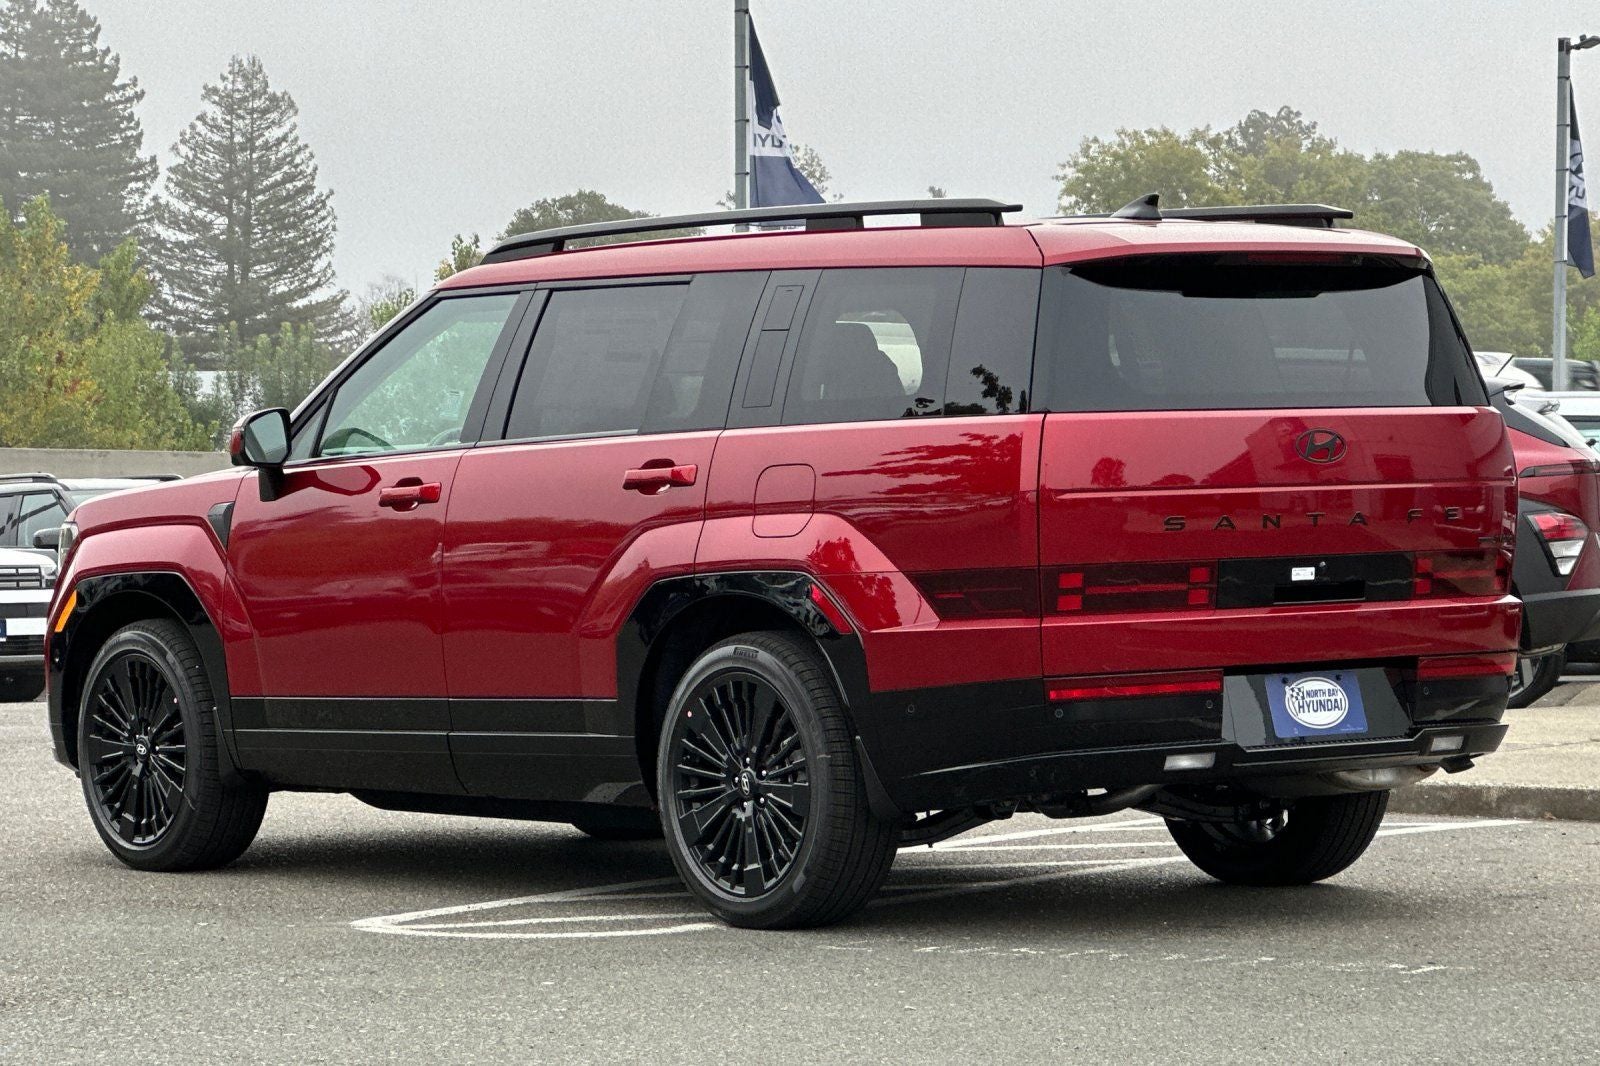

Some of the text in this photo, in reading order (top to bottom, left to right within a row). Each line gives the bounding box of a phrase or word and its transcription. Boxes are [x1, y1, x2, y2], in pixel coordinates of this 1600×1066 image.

[1163, 506, 1461, 531] SANTA FE
[1305, 687, 1339, 699] NORTH BAY
[1297, 698, 1343, 714] HYUNDAI
